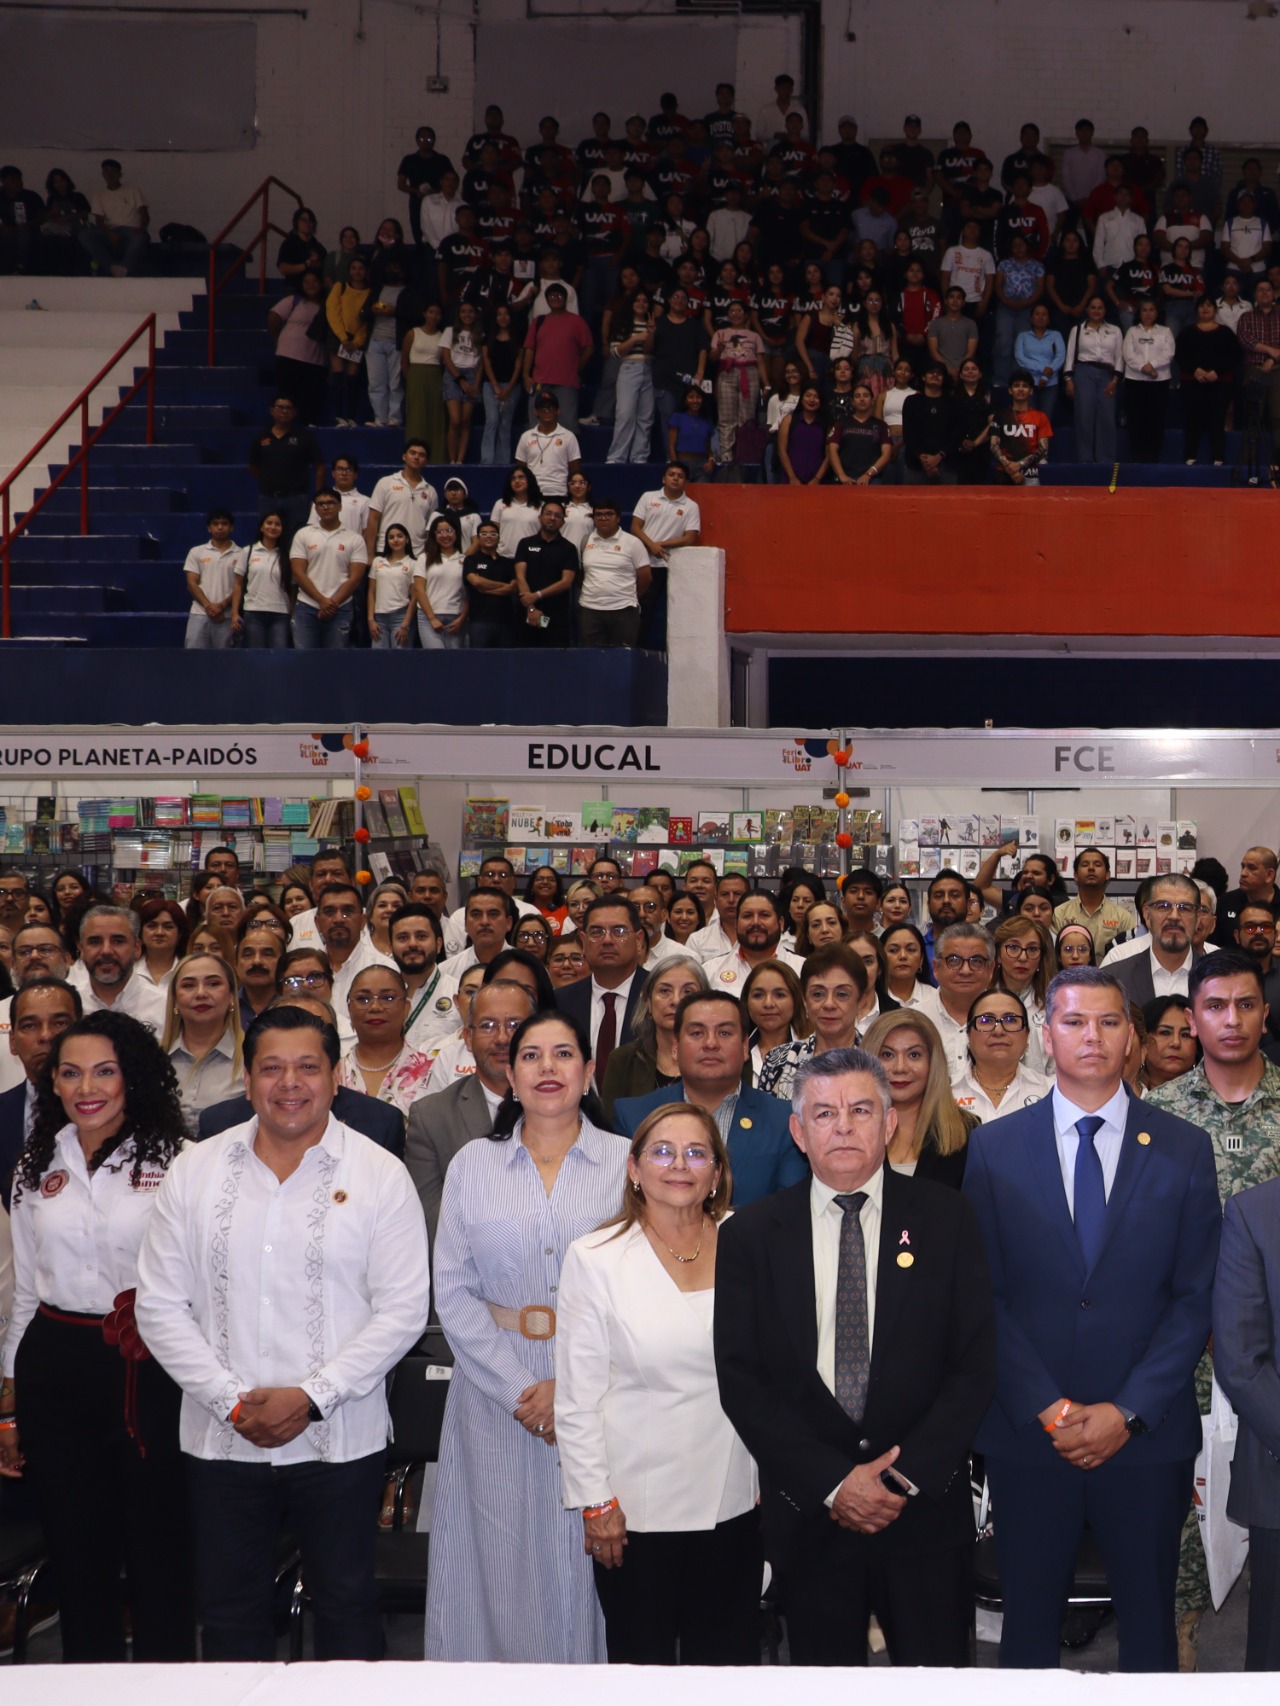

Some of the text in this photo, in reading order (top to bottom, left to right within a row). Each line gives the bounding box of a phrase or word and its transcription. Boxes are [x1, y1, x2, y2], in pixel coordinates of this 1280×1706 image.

[945, 156, 977, 168] UAT
[479, 216, 515, 228] UAT
[584, 211, 617, 224] UAT
[1008, 216, 1037, 228] UAT
[451, 245, 484, 258] UAT
[1129, 268, 1153, 279] UAT
[761, 298, 789, 310] UAT
[1003, 424, 1036, 438] UAT
[58, 743, 258, 767] PLANETA-PAIDÓS
[528, 744, 661, 771] EDUCAL
[1054, 745, 1115, 772] FCE
[312, 758, 329, 766] UAT
[795, 764, 812, 772] UAT
[511, 817, 535, 828] NUBE
[1102, 919, 1119, 927] UAT
